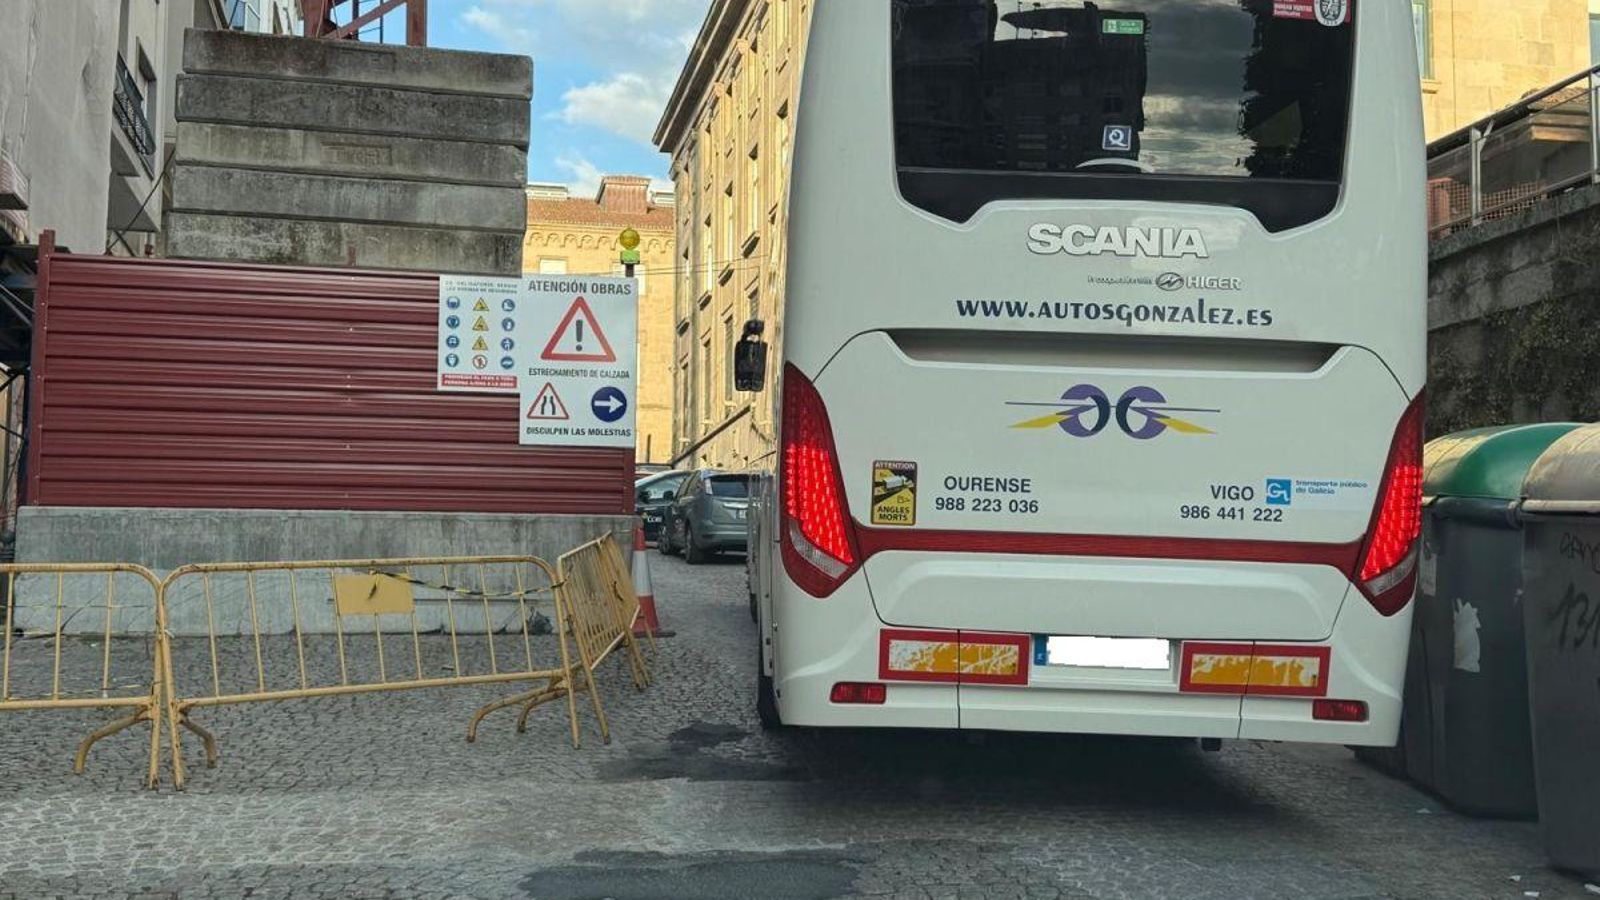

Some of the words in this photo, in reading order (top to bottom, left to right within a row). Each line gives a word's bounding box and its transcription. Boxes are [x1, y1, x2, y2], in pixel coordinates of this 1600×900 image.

[1027, 223, 1209, 259] SCANIA
[528, 279, 587, 294] ATENCIÓN
[591, 282, 631, 295] OBRAS
[1186, 276, 1242, 290] HIGER
[528, 367, 586, 377] ESTRECHAMIENTO
[600, 371, 630, 379] CALZADA
[526, 427, 569, 436] DISCULPEN
[571, 428, 586, 436] LAS
[588, 429, 632, 437] MOLESTIAS
[875, 461, 915, 470] ATTENTION
[944, 475, 1032, 493] OURENSE
[1211, 484, 1254, 501] VIGO
[877, 506, 910, 514] ANGLES
[935, 497, 965, 511] 988
[972, 499, 1002, 512] 223
[1009, 500, 1039, 513] 036
[879, 513, 908, 521] MORTS
[1180, 505, 1210, 519] 986
[1217, 507, 1244, 521] 441
[1253, 508, 1283, 522] 222
